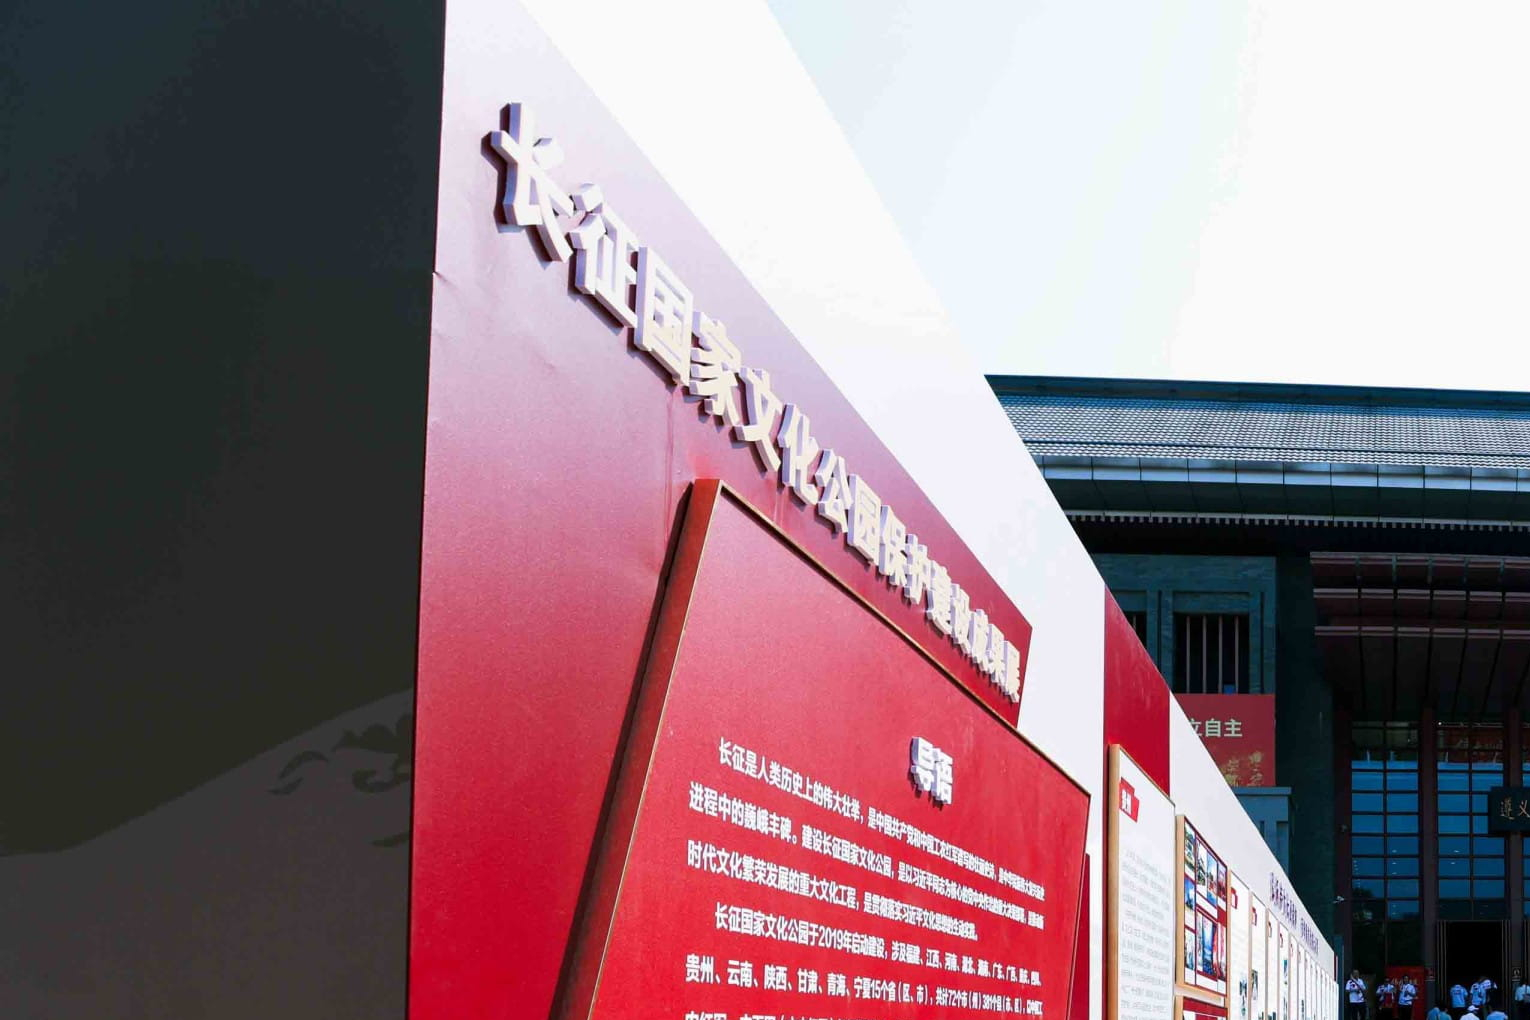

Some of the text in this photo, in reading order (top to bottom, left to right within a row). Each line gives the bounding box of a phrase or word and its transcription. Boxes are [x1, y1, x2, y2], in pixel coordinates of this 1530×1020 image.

[488, 102, 1021, 704] 长征国家文化公园保护建设成果展
[911, 736, 953, 805] 导语
